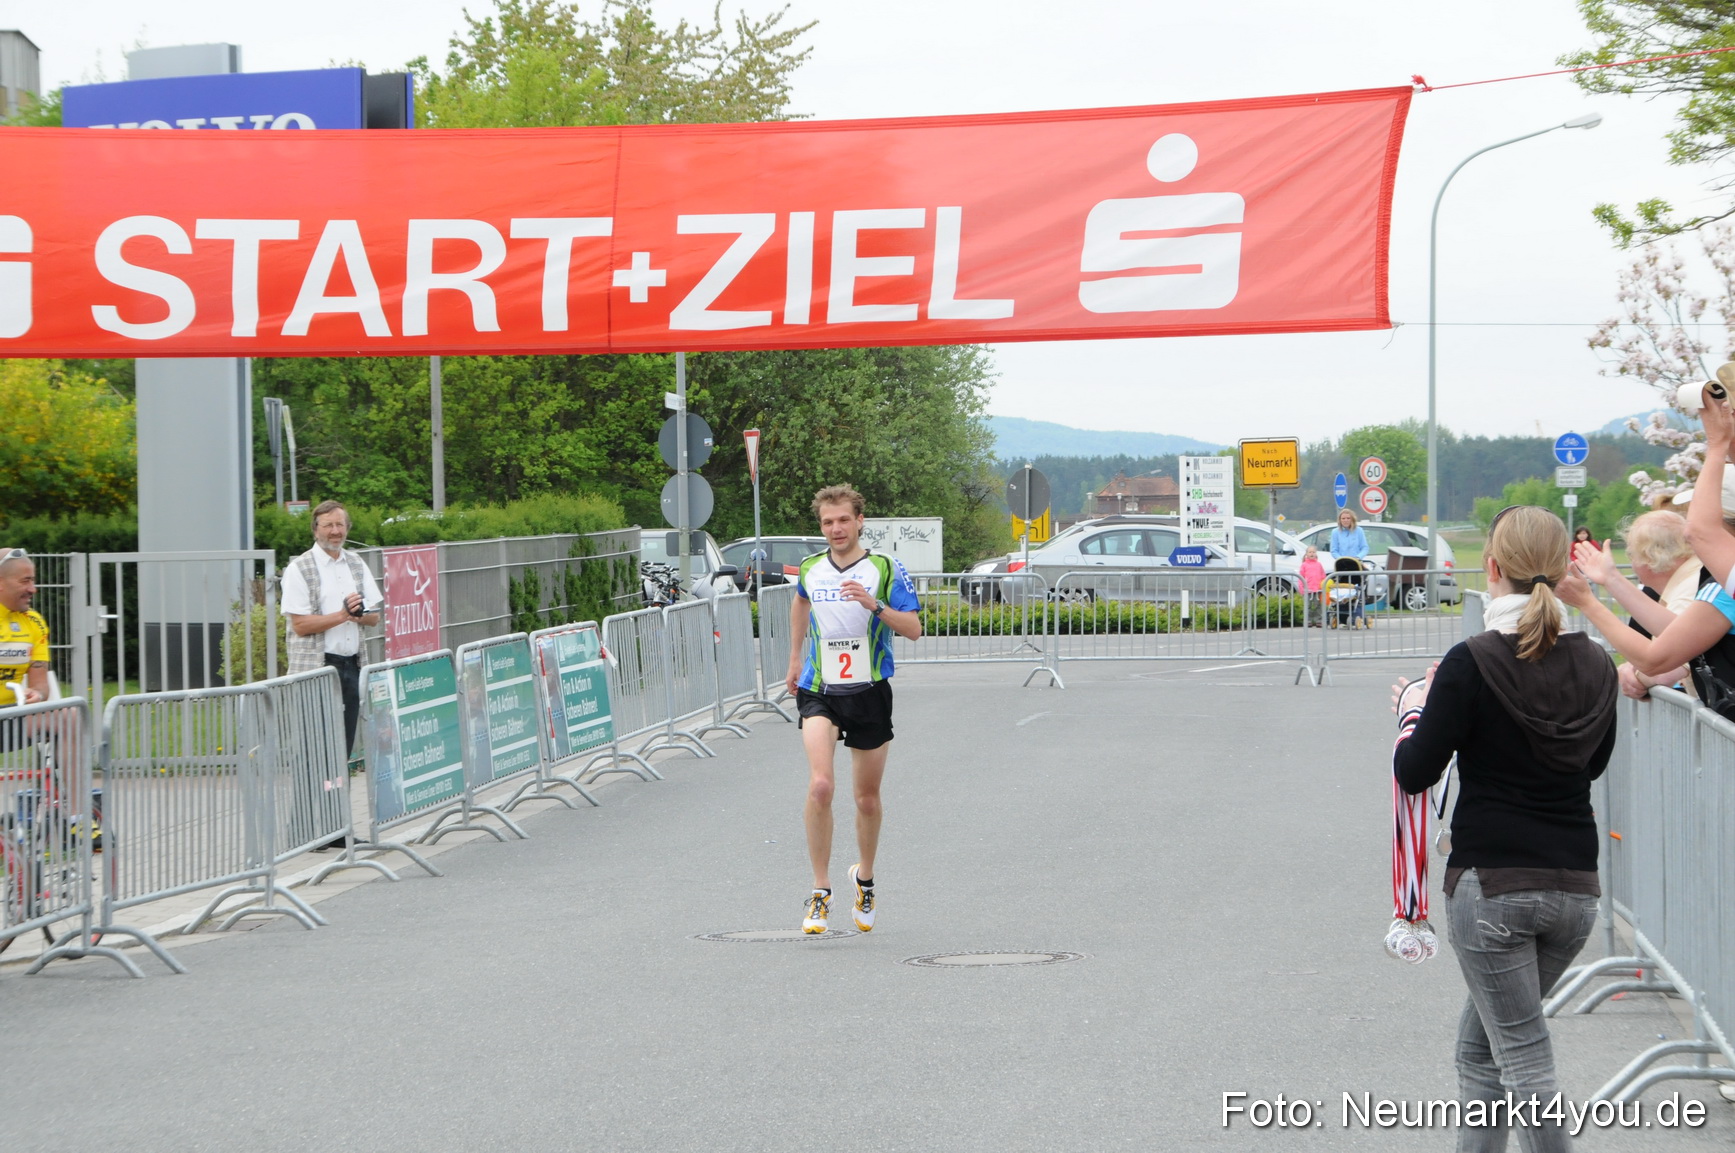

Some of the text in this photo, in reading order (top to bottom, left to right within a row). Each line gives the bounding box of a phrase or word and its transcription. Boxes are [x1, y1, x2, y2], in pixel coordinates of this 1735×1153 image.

[1247, 456, 1293, 468] Neumarkt
[1366, 465, 1381, 478] 60
[1192, 518, 1209, 529] THULE
[1176, 554, 1202, 564] VOLVO
[393, 600, 435, 637] ZEITLOS
[839, 653, 853, 679] 2
[563, 679, 571, 696] Fun
[575, 674, 586, 693] Action
[586, 673, 592, 690] in
[489, 698, 497, 716] Fun
[502, 690, 514, 713] Action
[514, 688, 519, 709] in
[567, 702, 583, 720] sicheren
[401, 722, 412, 742] Fun
[417, 716, 433, 738] Action
[433, 713, 439, 734] in
[491, 722, 508, 742] sicheren
[403, 750, 424, 772] sicheren
